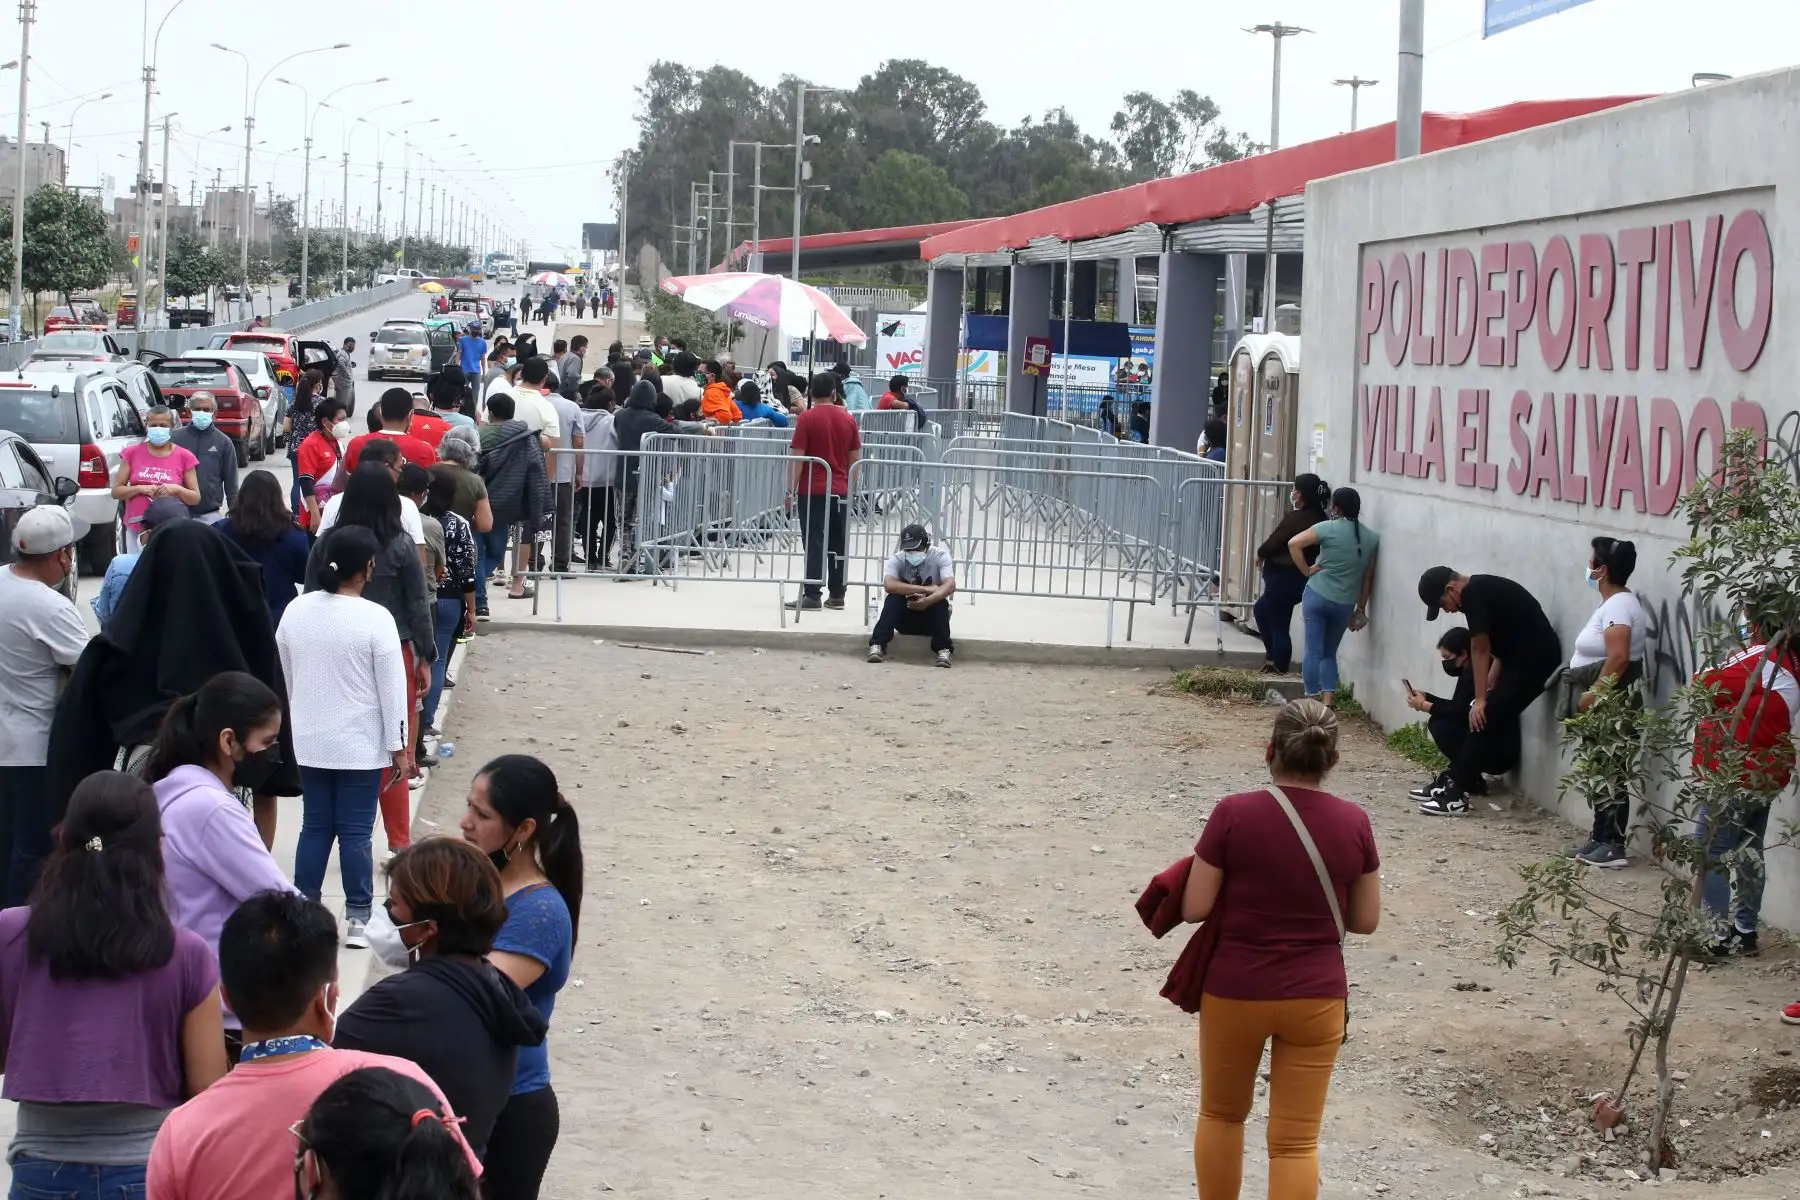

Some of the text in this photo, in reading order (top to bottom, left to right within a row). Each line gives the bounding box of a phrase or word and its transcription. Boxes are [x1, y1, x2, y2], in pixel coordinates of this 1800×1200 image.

[1361, 208, 1774, 372] POLIDEPORTIVO
[1074, 363, 1096, 372] Mesa
[1361, 384, 1446, 482] VILLA
[1455, 389, 1498, 491] EL
